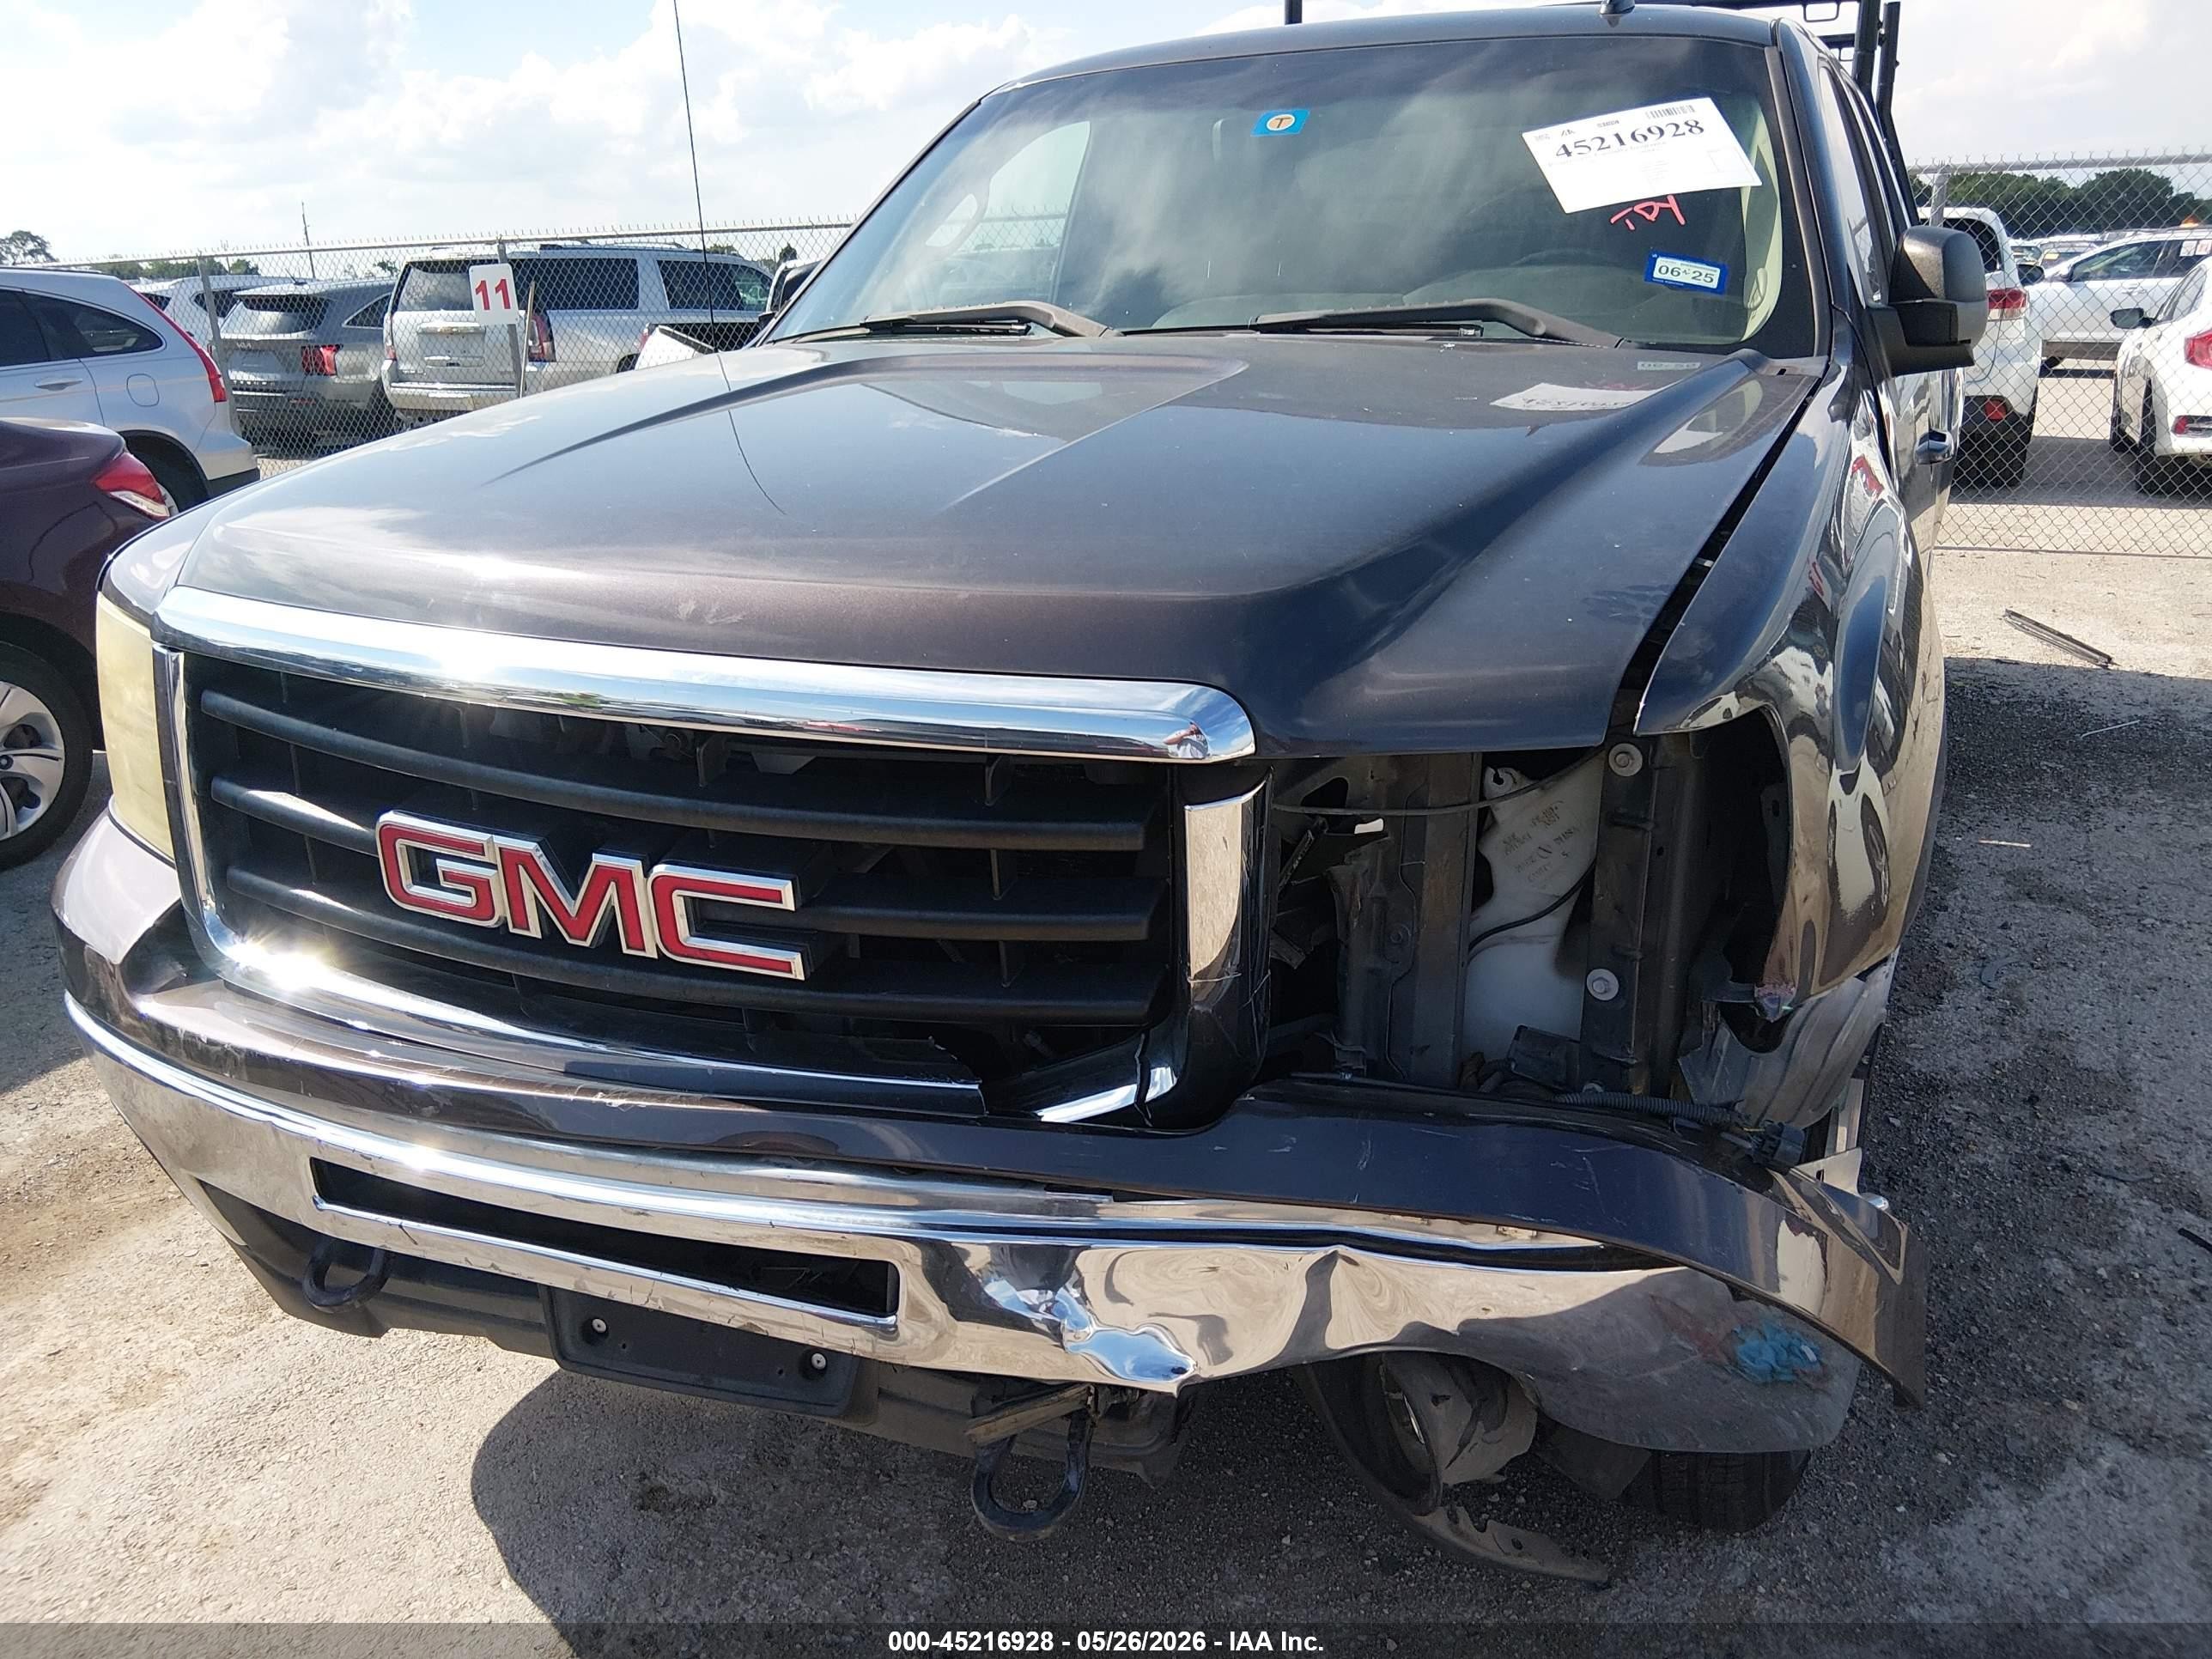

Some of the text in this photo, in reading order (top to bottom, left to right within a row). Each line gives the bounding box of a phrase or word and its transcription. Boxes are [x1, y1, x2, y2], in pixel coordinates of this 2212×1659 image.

[1556, 119, 1705, 157] 45216928
[475, 278, 511, 311] 11
[375, 809, 805, 981] GMC
